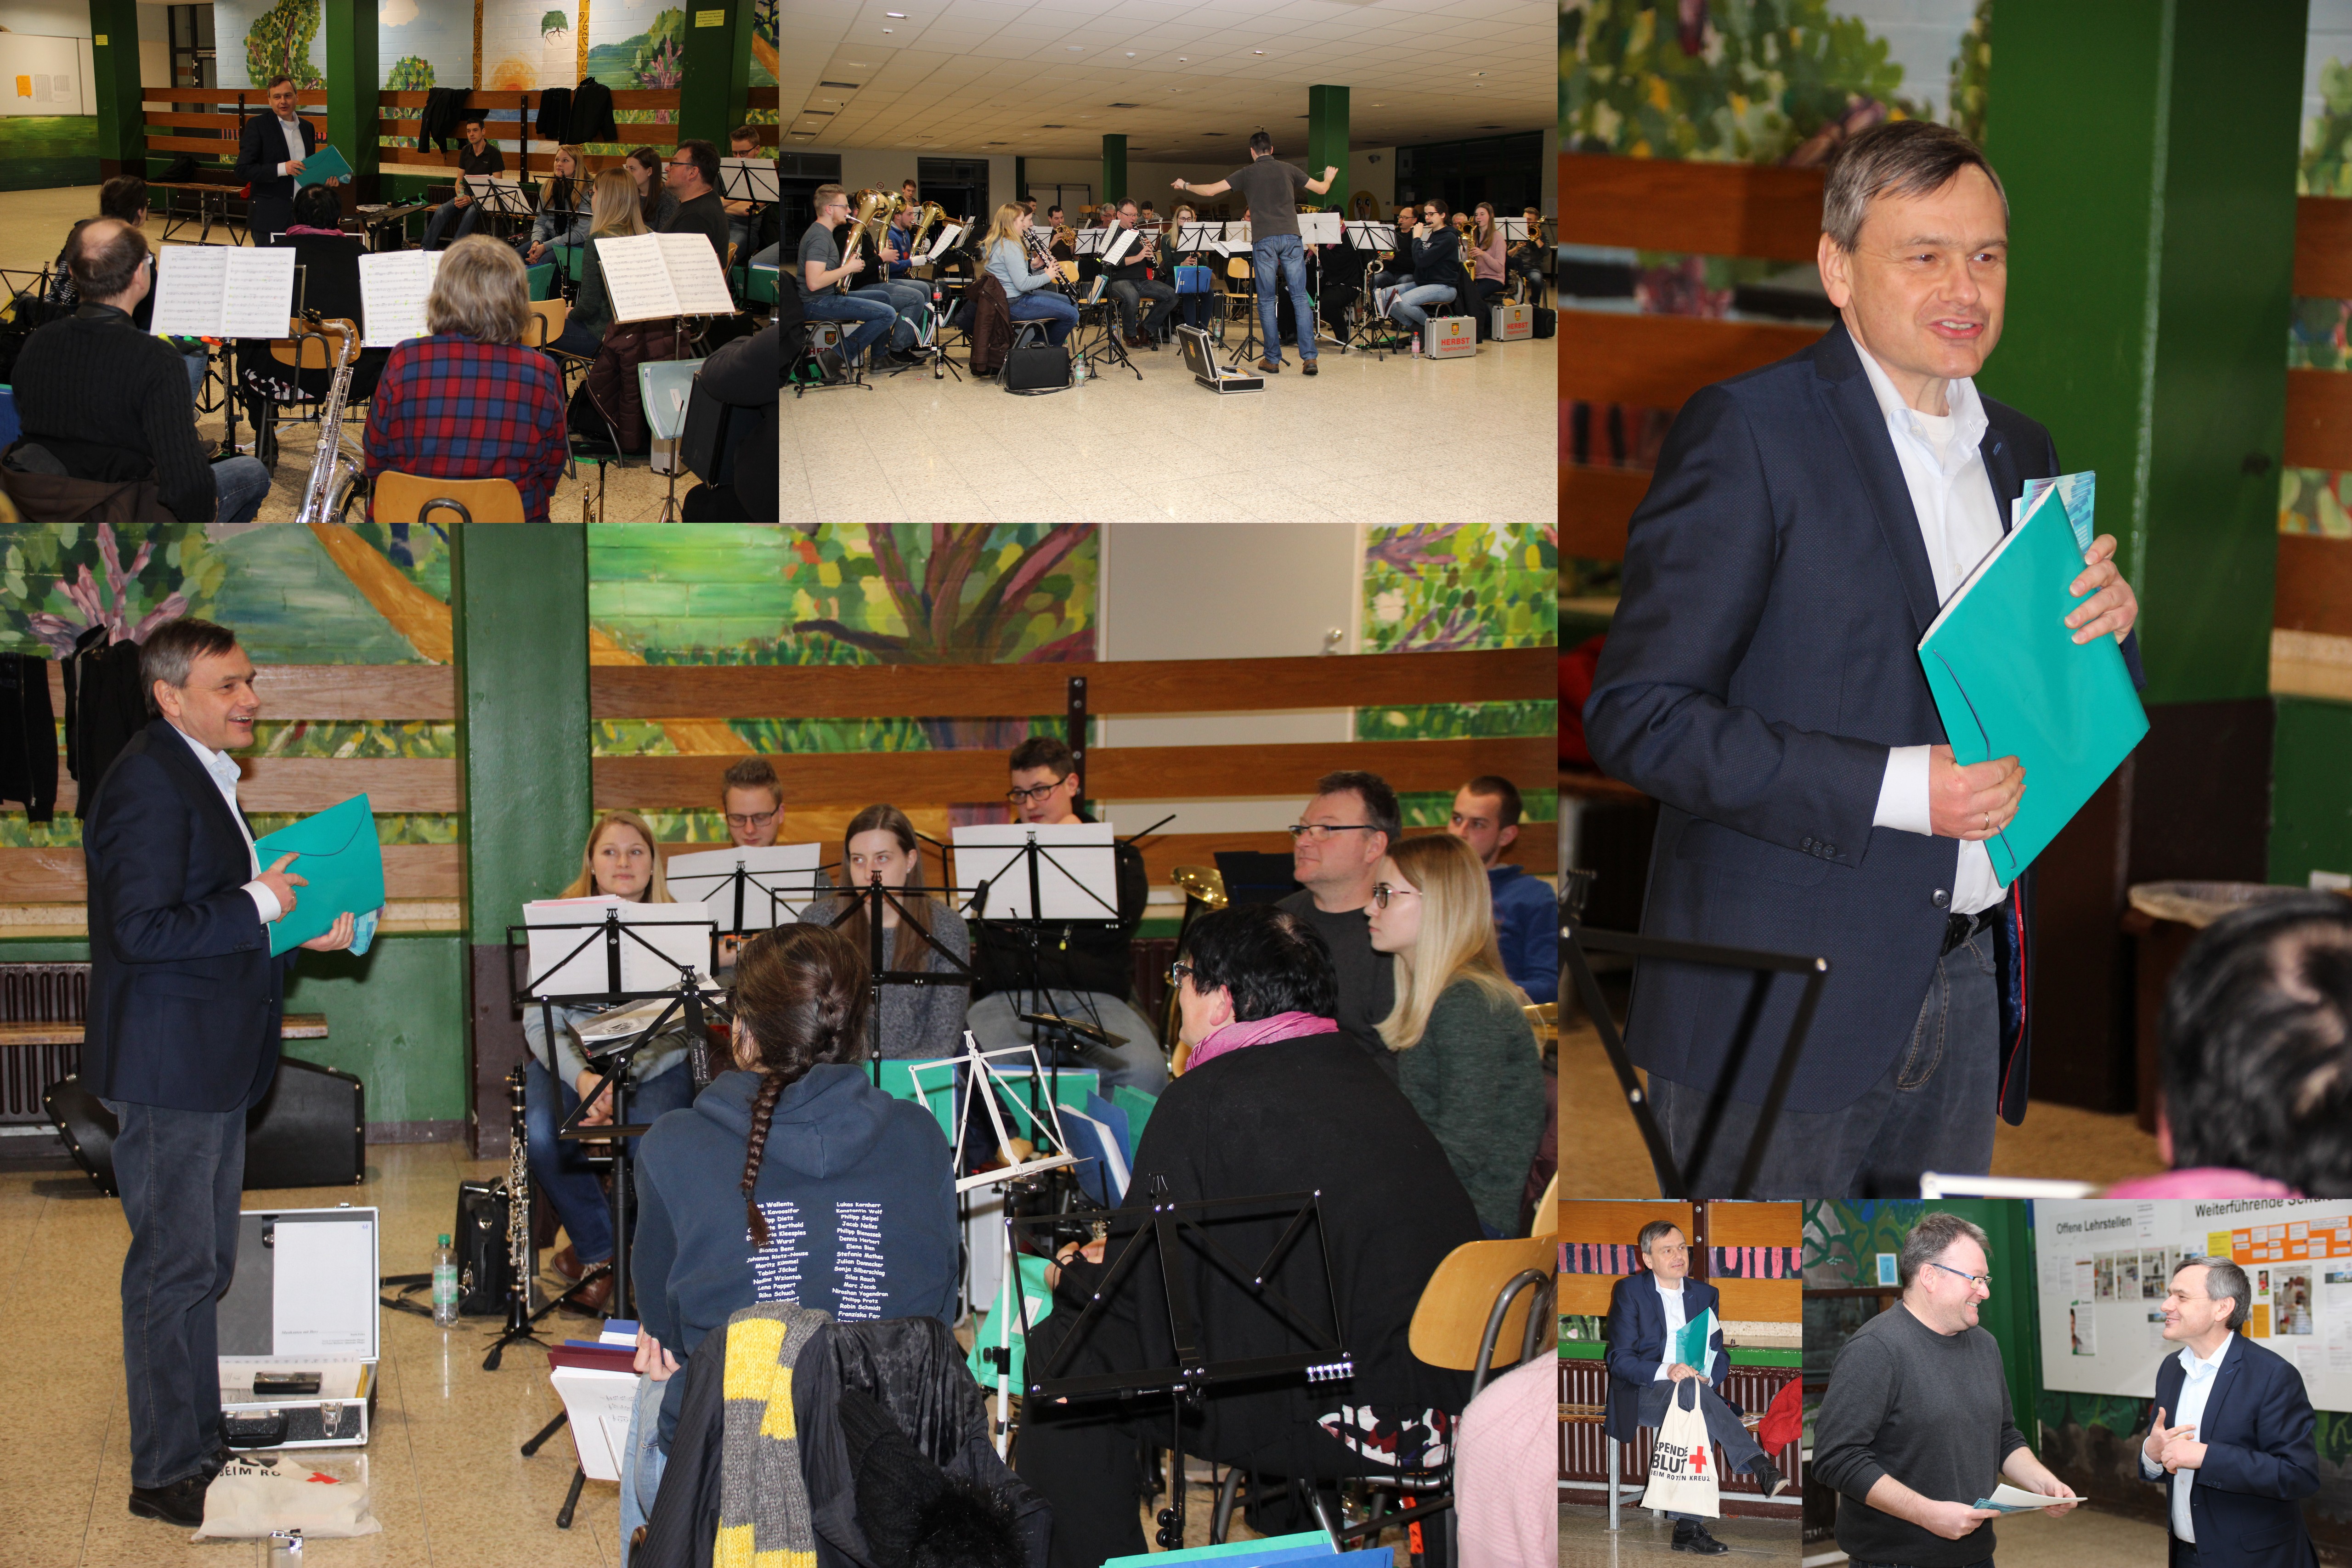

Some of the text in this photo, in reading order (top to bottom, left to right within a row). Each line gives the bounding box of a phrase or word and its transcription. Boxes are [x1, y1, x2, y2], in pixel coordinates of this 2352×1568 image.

[1441, 337, 1470, 346] HERBST
[2195, 1199, 2284, 1217] Weiterführende
[2056, 1222, 2082, 1234] Offene
[2084, 1216, 2132, 1232] Lehrstellen
[859, 1237, 880, 1245] Herbert
[856, 1259, 884, 1268] Donnecker
[853, 1267, 886, 1277] Silberschlag
[753, 1277, 772, 1285] Nadine
[832, 1287, 857, 1296] Niroshan
[1652, 1454, 1687, 1474] BLUT
